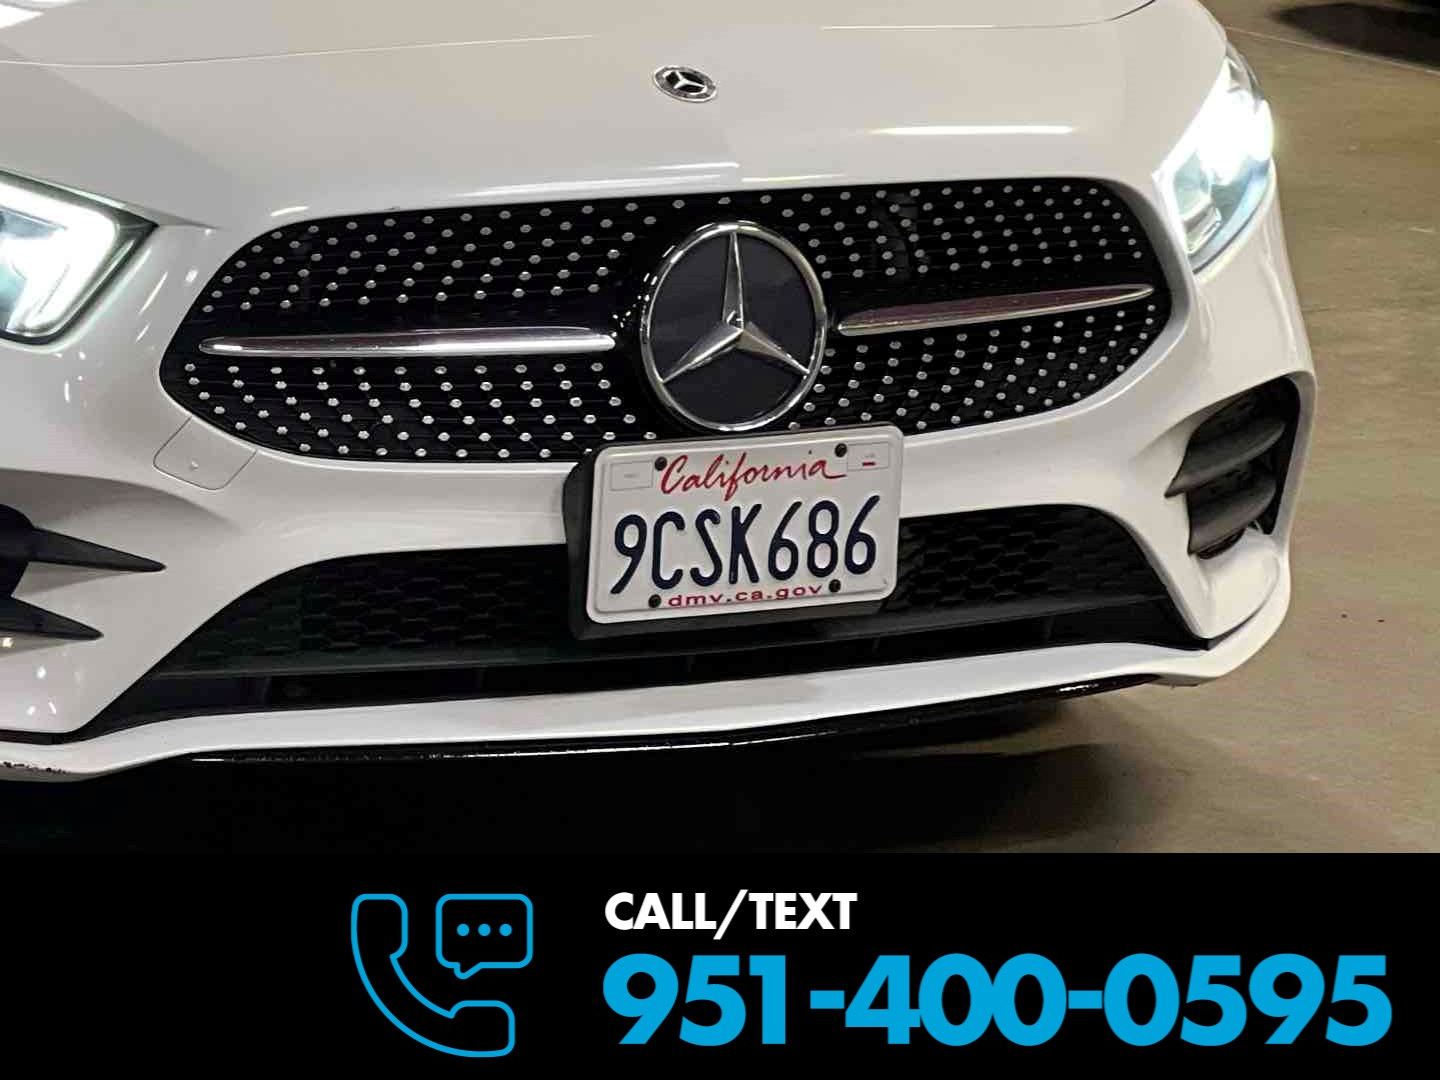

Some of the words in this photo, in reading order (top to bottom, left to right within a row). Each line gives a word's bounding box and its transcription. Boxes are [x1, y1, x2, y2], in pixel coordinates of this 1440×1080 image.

[660, 453, 846, 501] California
[610, 495, 880, 594] 9CSK686
[667, 582, 823, 608] dmv.ca.gov
